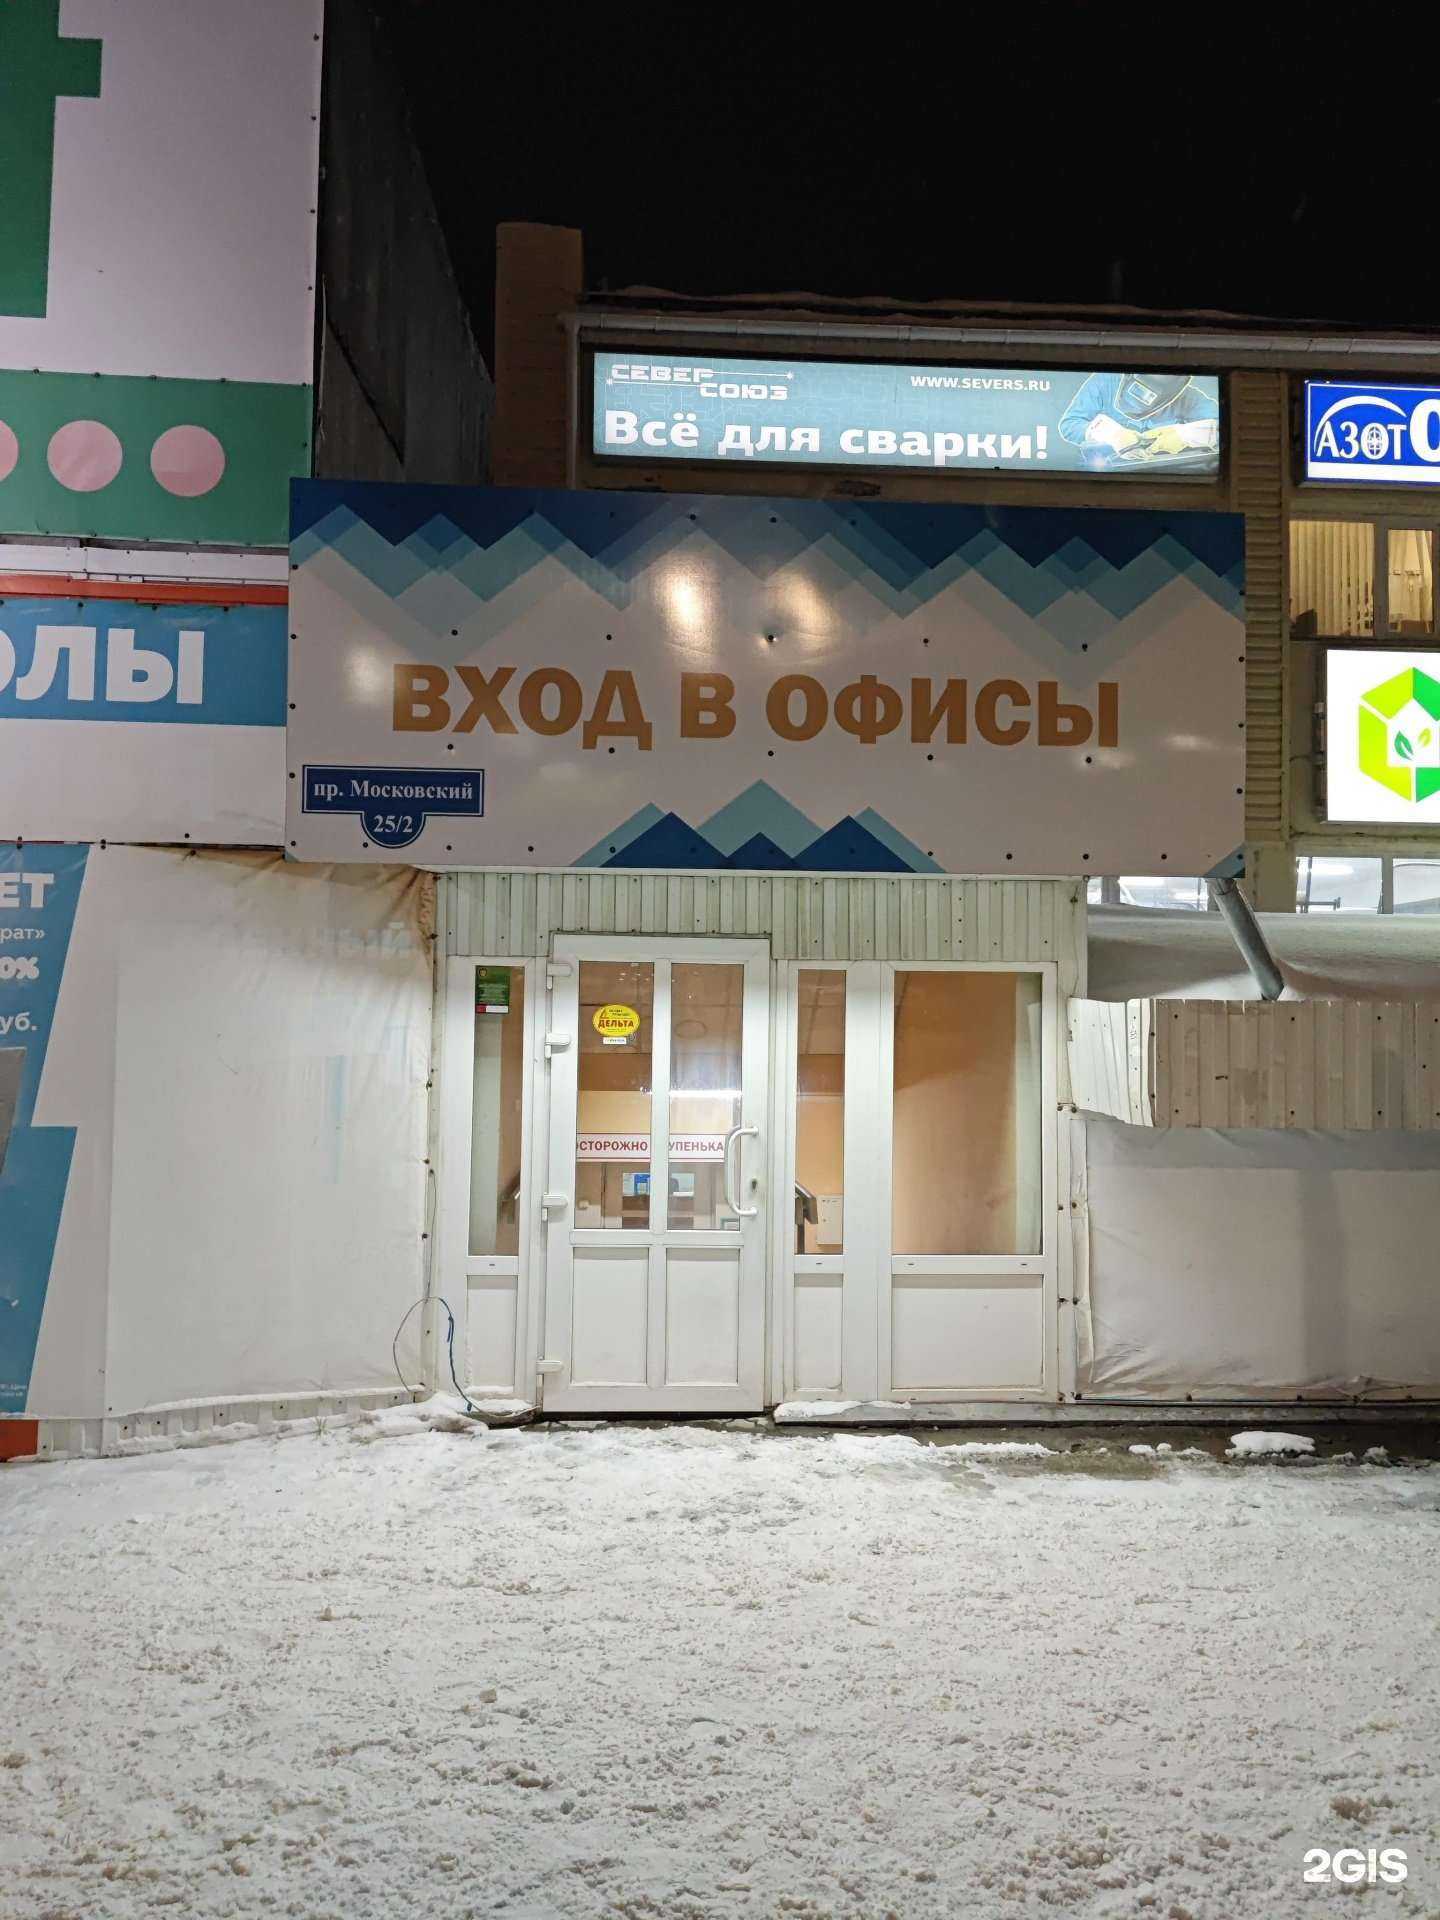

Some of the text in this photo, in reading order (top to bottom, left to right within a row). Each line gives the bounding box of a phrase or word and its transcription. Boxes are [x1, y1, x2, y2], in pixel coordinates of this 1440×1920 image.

[611, 364, 714, 383] СЕВЕР
[911, 375, 1050, 391] WWW.SEVERS.RU
[700, 382, 788, 401] СОЮЗ
[605, 409, 1048, 466] Всё для сварки!
[0, 624, 205, 704] ЛЫ
[392, 663, 1119, 751] ВХОД В ОФИСЫ
[314, 779, 473, 801] пр. Московский
[373, 815, 413, 833] 25/2
[598, 1019, 634, 1028] ДЕЛЬТА
[576, 1140, 724, 1152] СТОРОЖНО УПЕНЬКА
